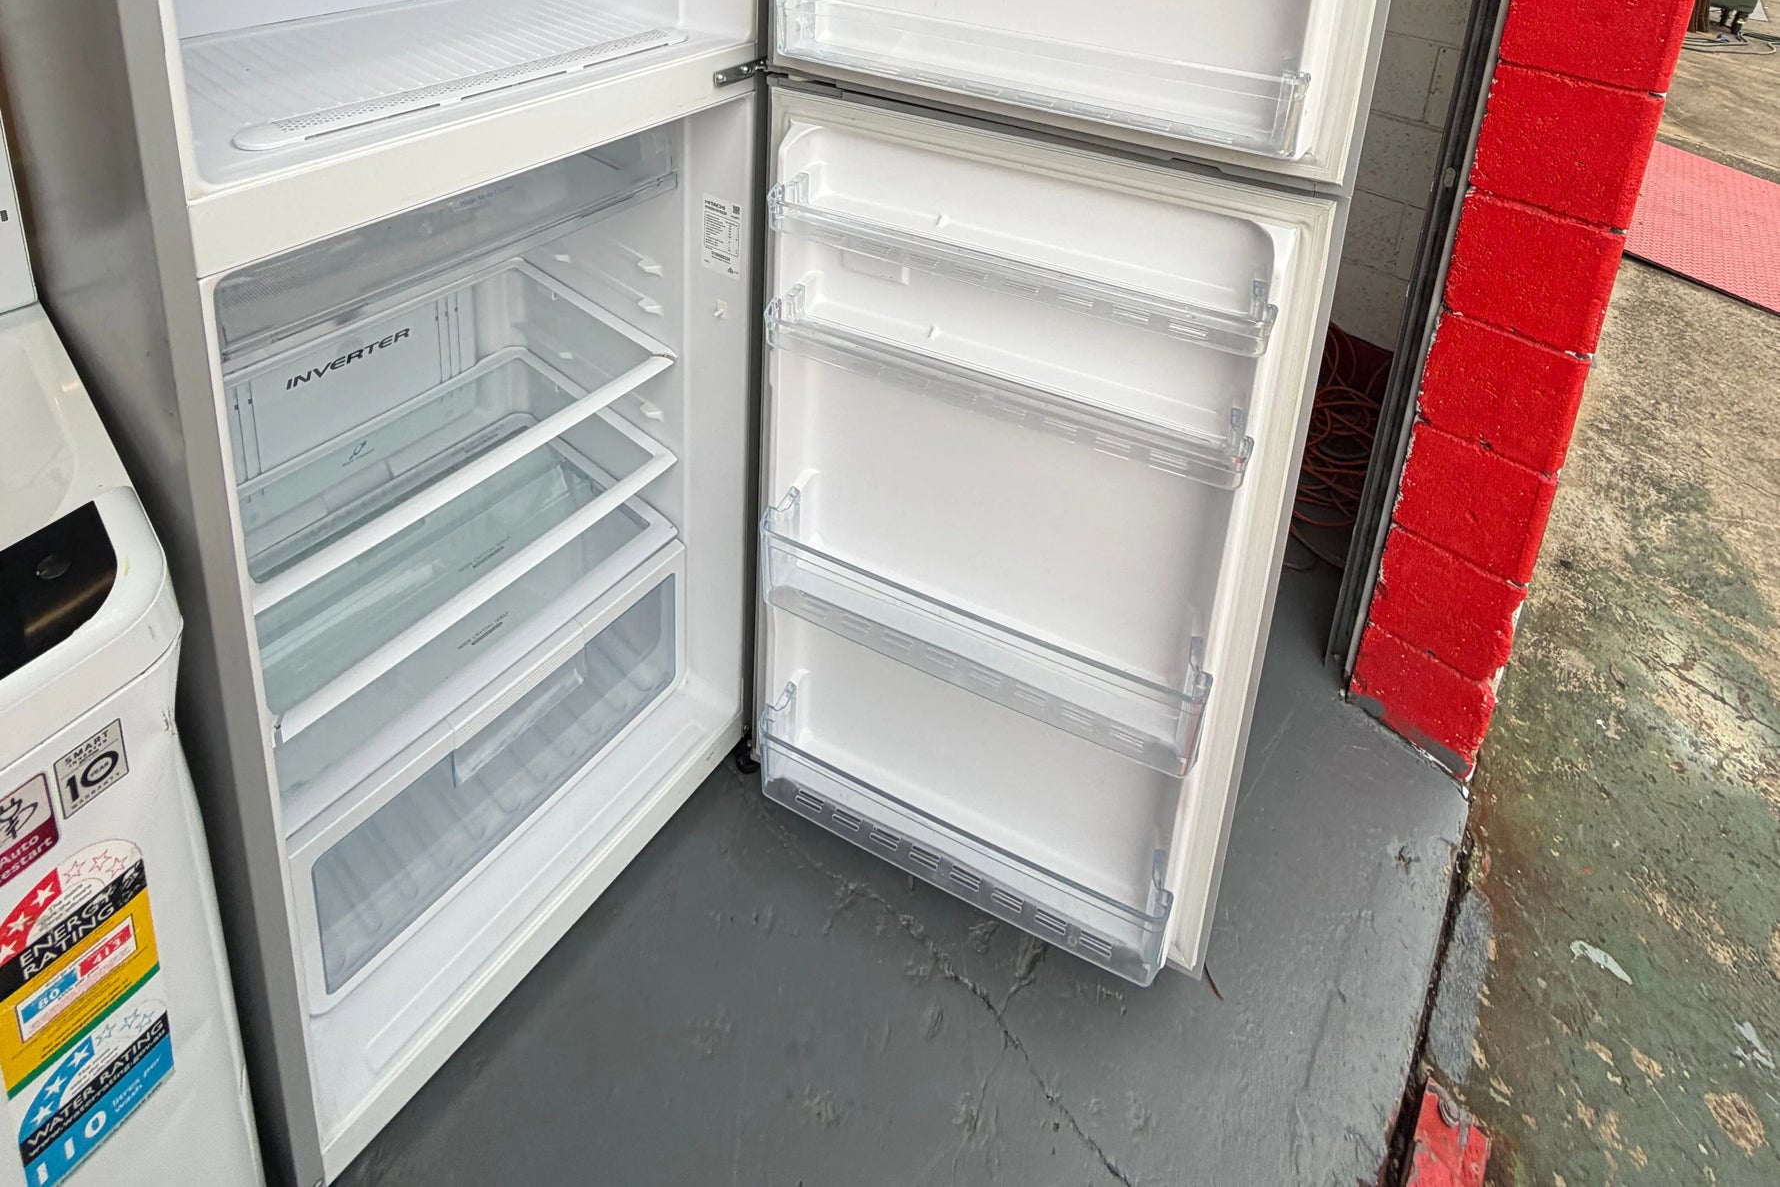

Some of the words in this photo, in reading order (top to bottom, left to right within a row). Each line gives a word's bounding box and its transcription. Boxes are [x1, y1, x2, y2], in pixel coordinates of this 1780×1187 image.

[704, 199, 726, 211] HITACHI
[286, 327, 410, 391] INVERTER
[64, 729, 109, 766] SMART
[66, 750, 119, 803] 10
[0, 835, 40, 868] Auto
[0, 836, 53, 880] estart
[20, 883, 115, 968] ENERGY
[23, 905, 114, 981] RATING
[93, 936, 122, 965] 413
[27, 1085, 95, 1146] WATER
[99, 1019, 163, 1085] RATING
